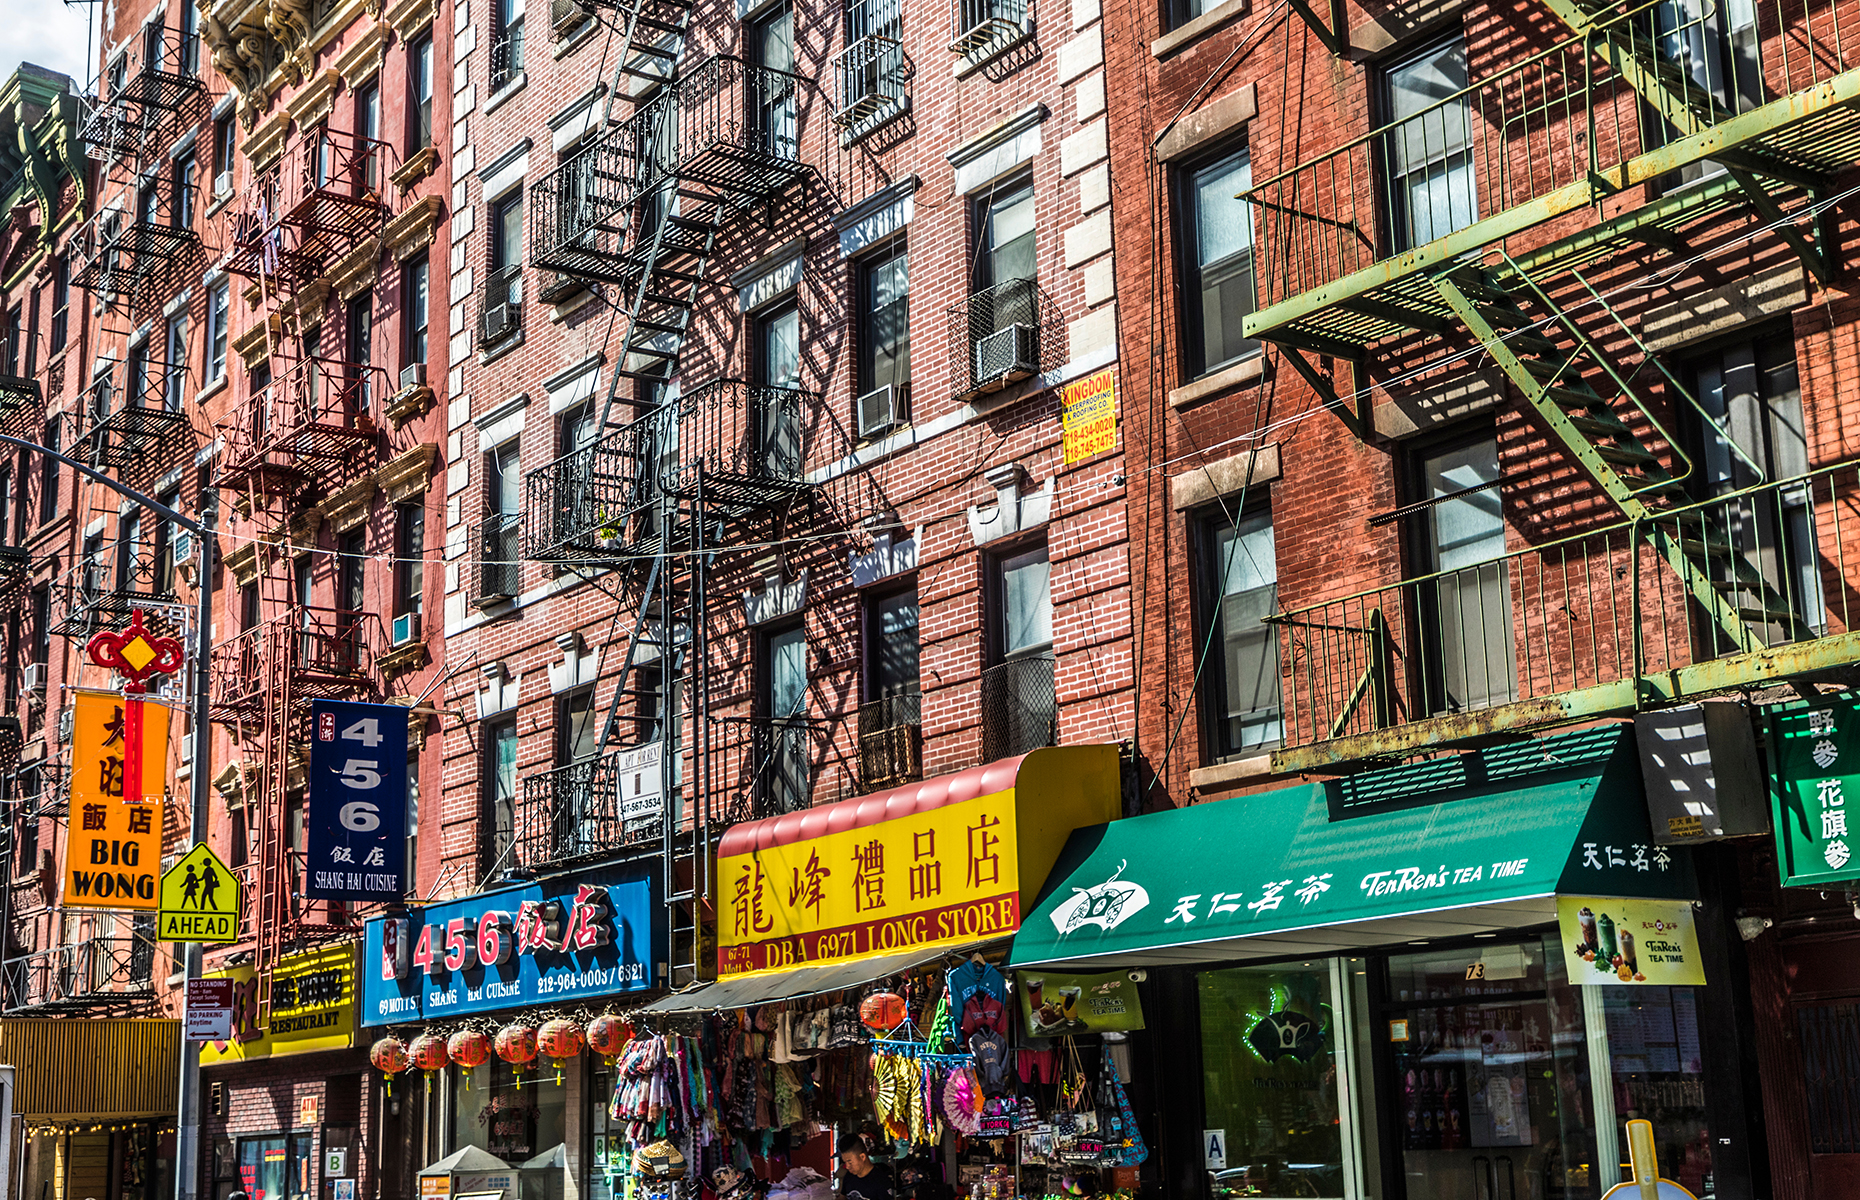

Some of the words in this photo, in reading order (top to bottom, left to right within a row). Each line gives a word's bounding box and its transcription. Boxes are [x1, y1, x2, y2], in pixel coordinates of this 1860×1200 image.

[1063, 373, 1111, 406] KINGDOM
[1073, 404, 1098, 419] ROOFING
[1065, 416, 1114, 446] 718-434-0020
[1066, 432, 1114, 460] 718-745-7475
[637, 750, 646, 763] FOR
[647, 745, 660, 760] RENT
[82, 802, 153, 834] 飯店
[90, 839, 139, 866] BIG
[330, 845, 385, 866] 飯店
[1582, 842, 1671, 872] 天仁茗茶
[315, 871, 344, 890] SHANG
[347, 873, 362, 890] HAI
[365, 873, 397, 892] CUISINE
[731, 814, 1000, 938] 龍峰禮品店
[1452, 866, 1482, 884] TEA
[1490, 858, 1528, 879] TIME
[72, 870, 154, 900] WONG
[1164, 873, 1333, 924] 天仁茗茶
[167, 917, 229, 937] AHEAD
[765, 938, 808, 969] DBA
[817, 930, 857, 960] 6971
[867, 916, 928, 952] LONG
[938, 897, 1014, 940] STORE
[728, 946, 750, 961] 67-71
[1648, 955, 1664, 963] TEA
[1665, 955, 1684, 963] TIME
[1467, 963, 1484, 979] 73
[429, 989, 457, 1007] SHANG
[467, 986, 482, 1002] HAI
[486, 980, 520, 999] CUISINE
[379, 1000, 388, 1016] 69
[389, 997, 409, 1013] MOTT
[1108, 1006, 1126, 1014] TIME
[189, 1019, 212, 1027] Anytime
[270, 1010, 340, 1035] RESTAURANT
[980, 1041, 997, 1051] NYPD
[302, 1098, 317, 1112] ATM
[597, 1139, 603, 1156] B
[1209, 1134, 1222, 1158] A
[330, 1156, 340, 1170] B
